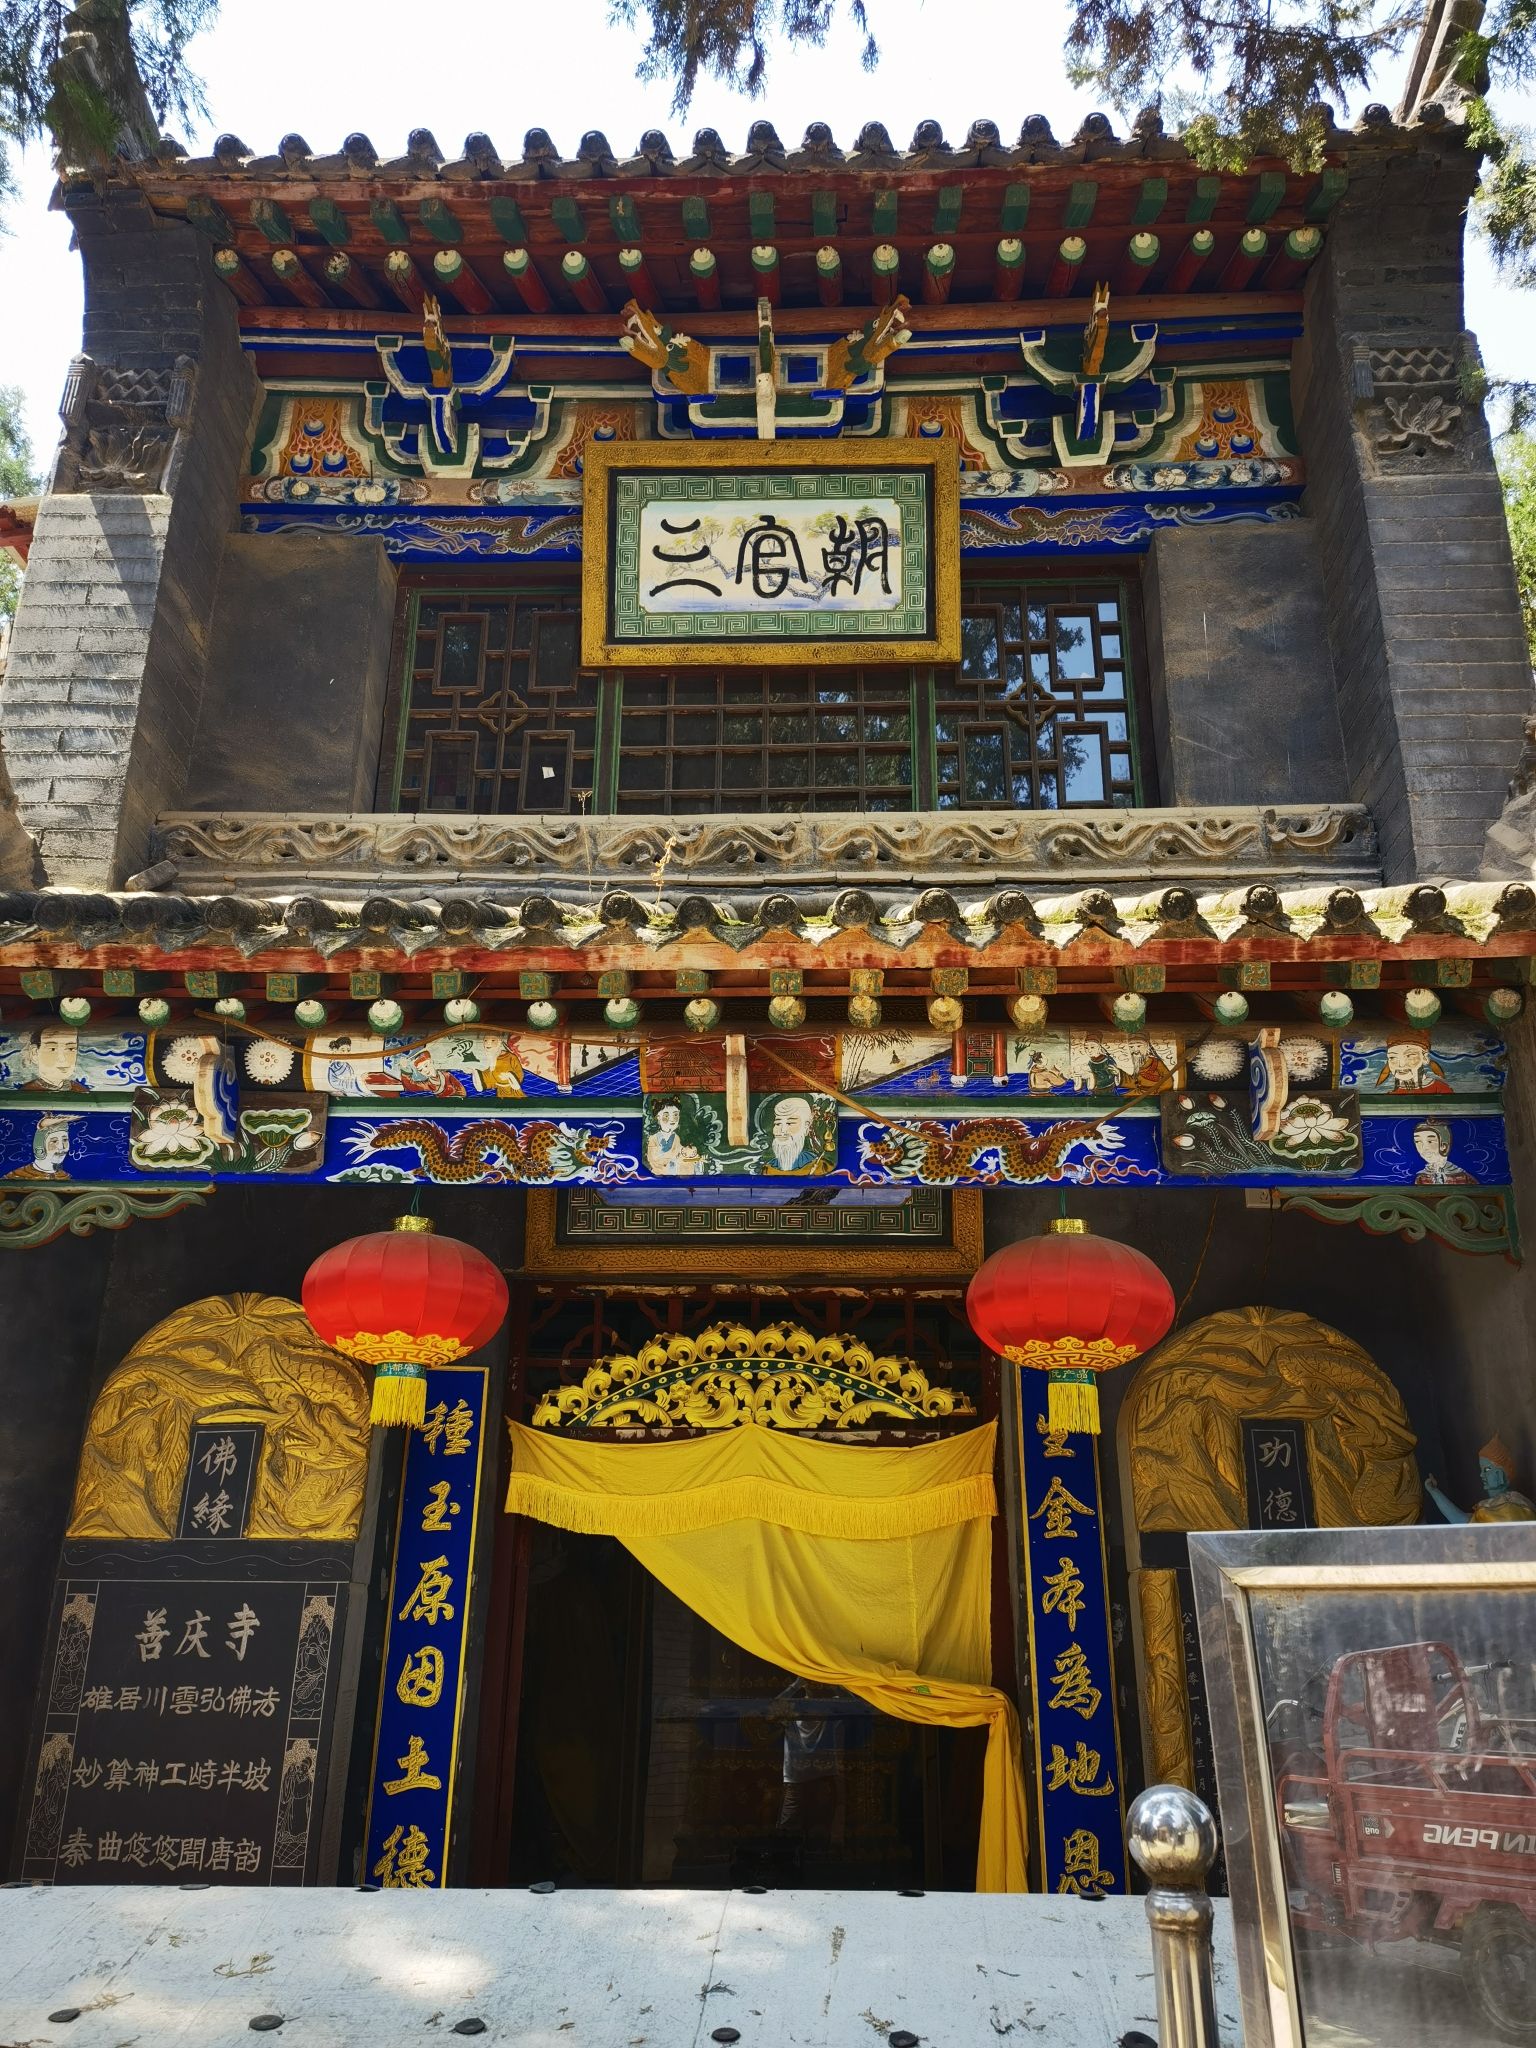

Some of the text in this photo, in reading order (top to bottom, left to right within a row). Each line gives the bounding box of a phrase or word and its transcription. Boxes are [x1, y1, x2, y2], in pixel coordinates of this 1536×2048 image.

[190, 1435, 238, 1535] 佛緣
[1258, 1436, 1297, 1522] 功德
[134, 1603, 261, 1662] 善庆寺
